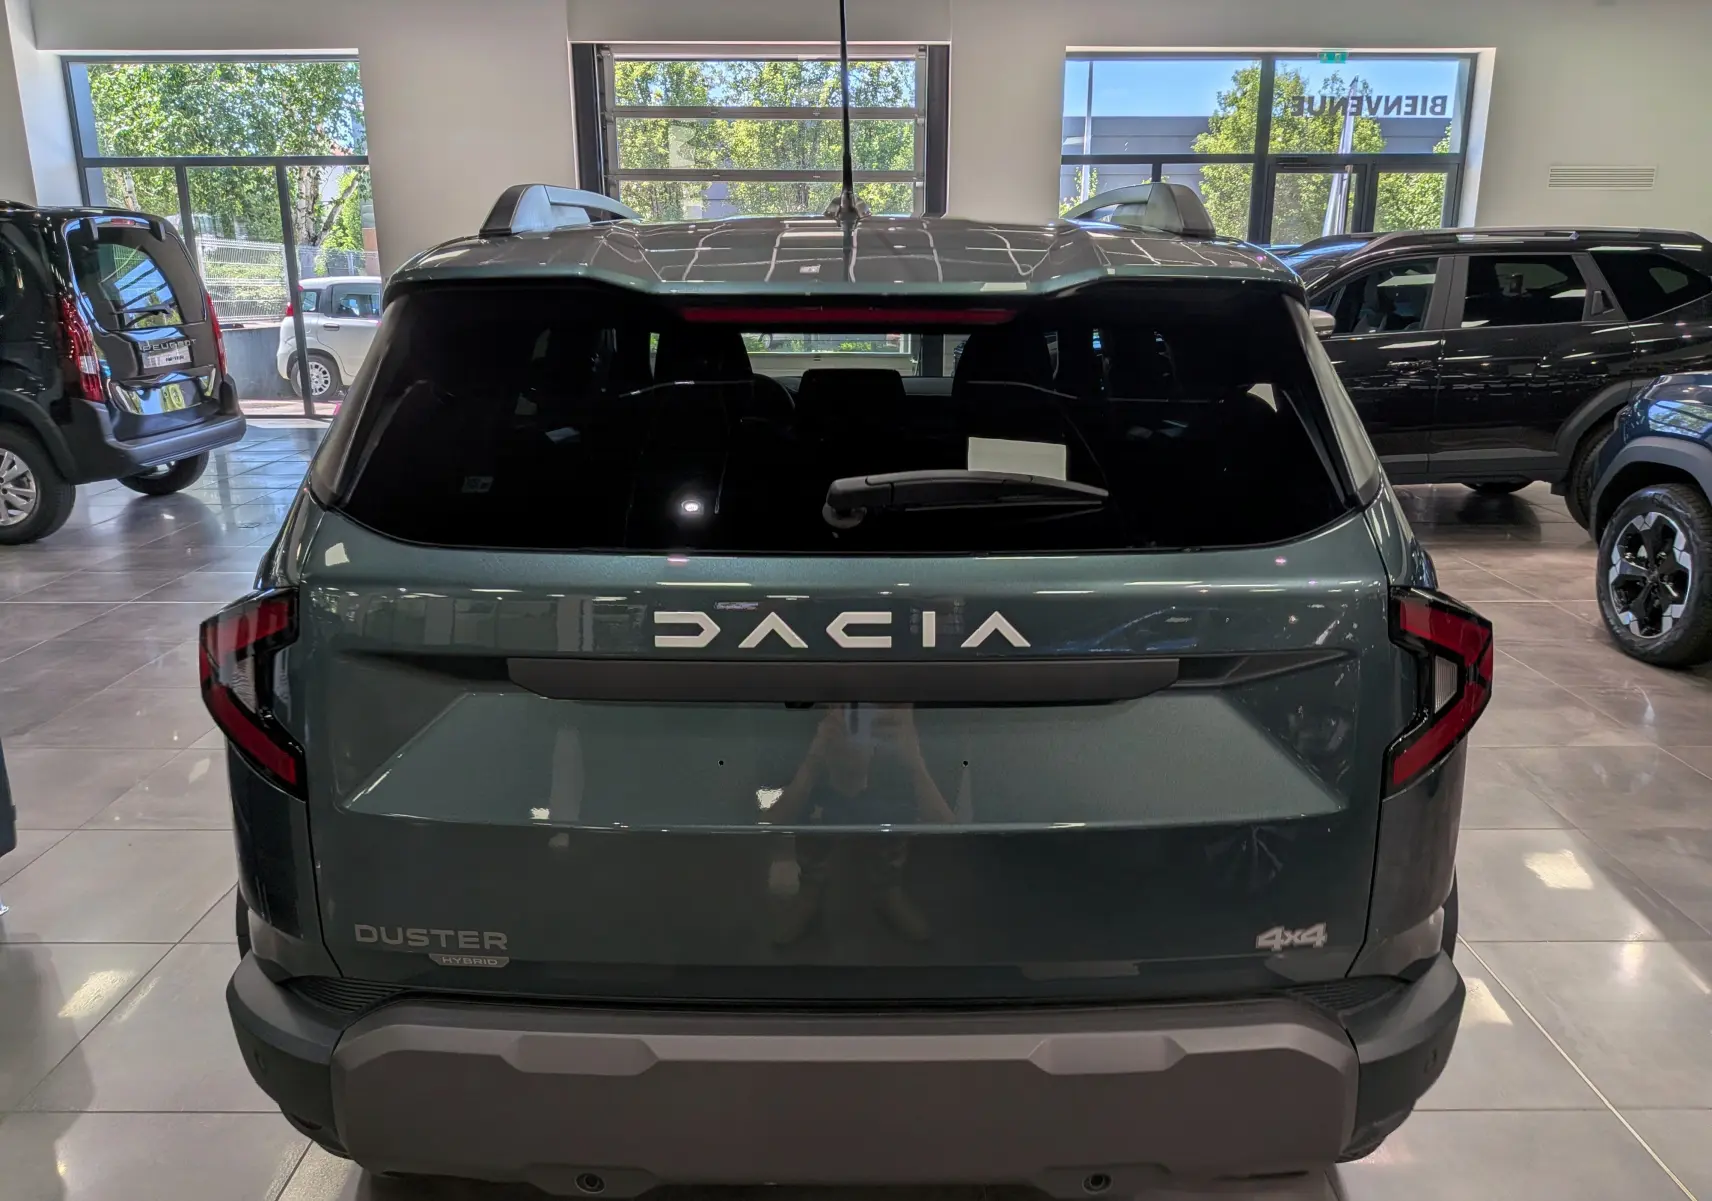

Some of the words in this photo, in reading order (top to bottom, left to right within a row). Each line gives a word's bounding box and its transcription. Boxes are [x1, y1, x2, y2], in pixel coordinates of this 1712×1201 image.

[654, 611, 1031, 648] DACIA
[354, 924, 508, 950] DUSTER
[1256, 921, 1328, 951] 4x4
[441, 956, 498, 966] HYBRID
